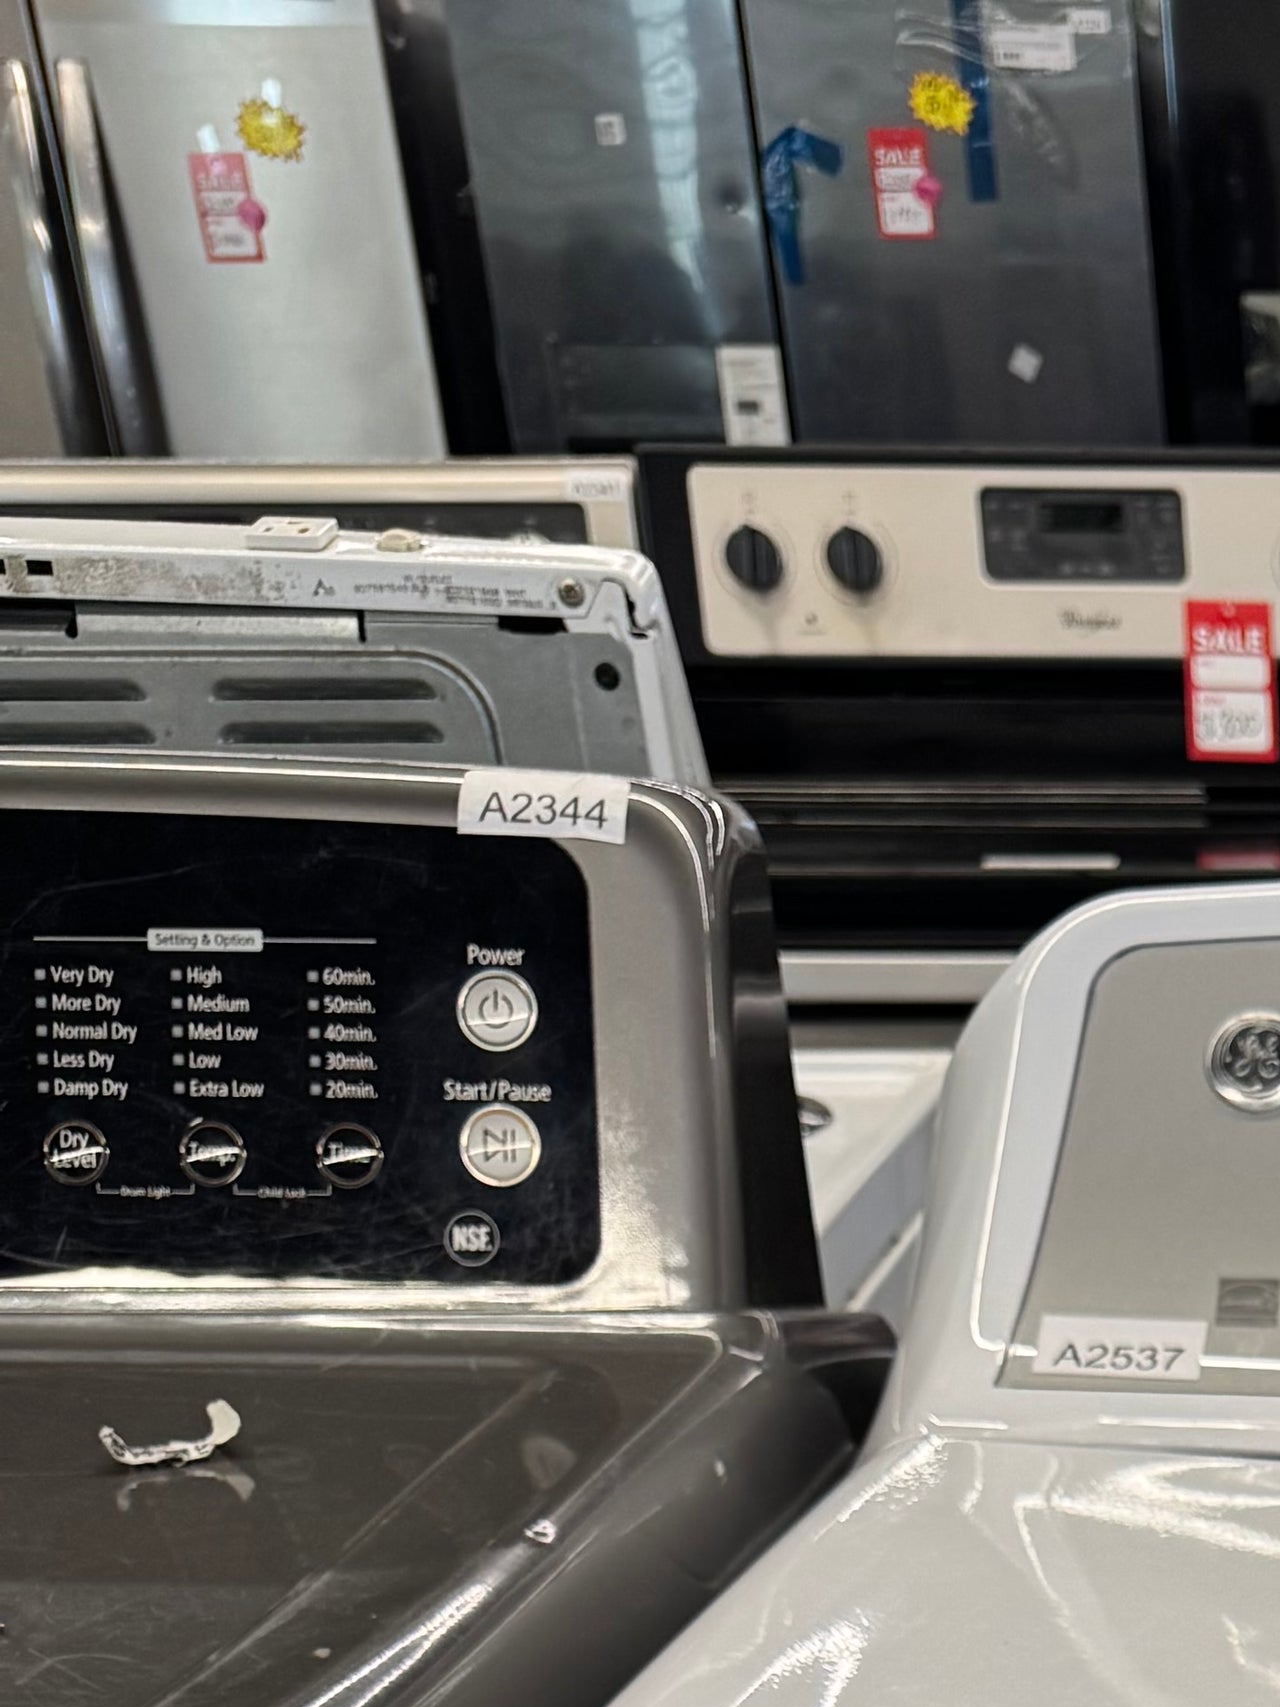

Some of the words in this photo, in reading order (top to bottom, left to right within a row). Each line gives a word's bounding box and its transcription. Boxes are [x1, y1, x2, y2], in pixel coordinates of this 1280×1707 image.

[875, 148, 921, 166] SALE
[1192, 626, 1263, 653] SALE
[479, 791, 609, 830] A2344
[155, 932, 198, 949] Setting
[201, 933, 211, 946] &
[214, 933, 255, 949] Option
[466, 943, 526, 966] Power
[50, 966, 84, 987] Very
[88, 965, 114, 988] Dry
[186, 966, 223, 988] High
[322, 967, 376, 986] 60min.
[52, 994, 92, 1011] More
[95, 993, 121, 1016] Dry
[187, 994, 250, 1012] Medium
[323, 995, 376, 1014] 50min.
[52, 1021, 108, 1041] Normal
[111, 1022, 138, 1044] Dry
[187, 1022, 223, 1041] Med
[226, 1022, 259, 1041] Low
[324, 1023, 377, 1043] 40min.
[53, 1050, 85, 1068] Less
[88, 1050, 114, 1072] Dry
[188, 1050, 222, 1069] Low
[324, 1051, 378, 1071] 30min.
[54, 1077, 99, 1100] Damp
[102, 1078, 128, 1101] Dry
[189, 1078, 229, 1098] Extra
[231, 1079, 265, 1098] Low
[325, 1079, 379, 1100] 20min.
[442, 1077, 552, 1102] Start/Pause
[59, 1129, 90, 1152] Dry
[1053, 1342, 1185, 1372] A2537
